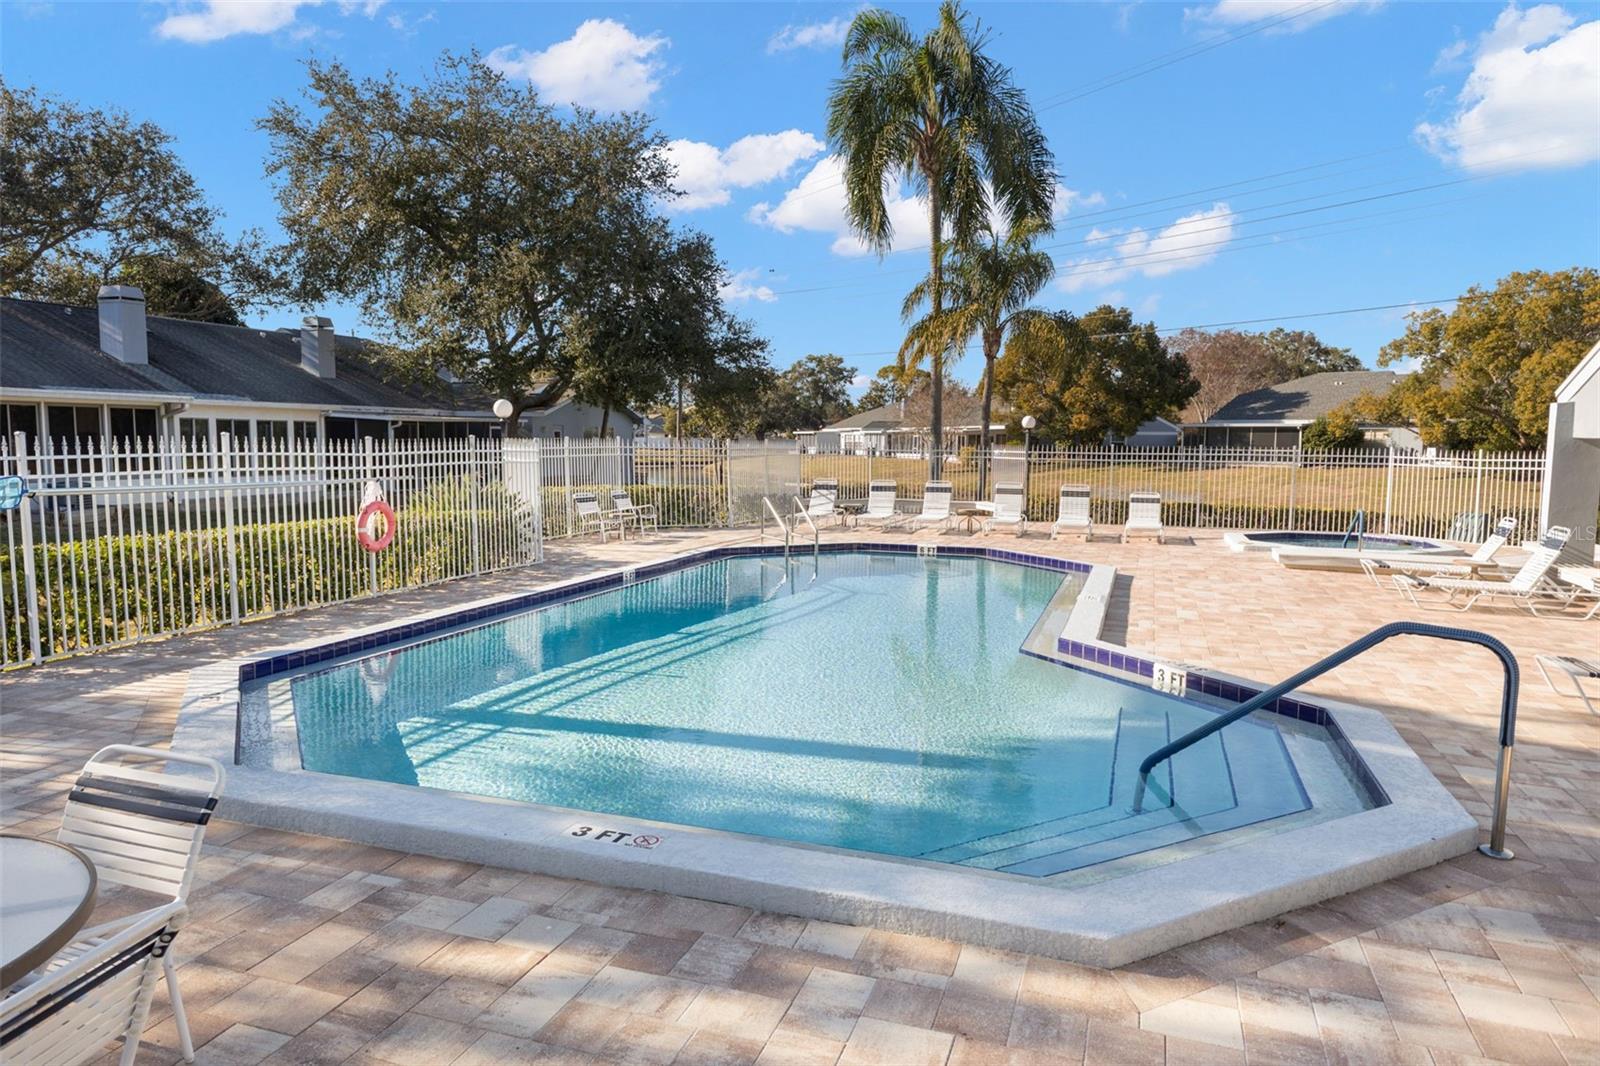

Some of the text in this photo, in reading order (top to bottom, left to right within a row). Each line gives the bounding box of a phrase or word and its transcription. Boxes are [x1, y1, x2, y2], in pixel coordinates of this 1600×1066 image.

[1158, 668, 1185, 687] 3 FT
[571, 826, 632, 843] 3 FT
